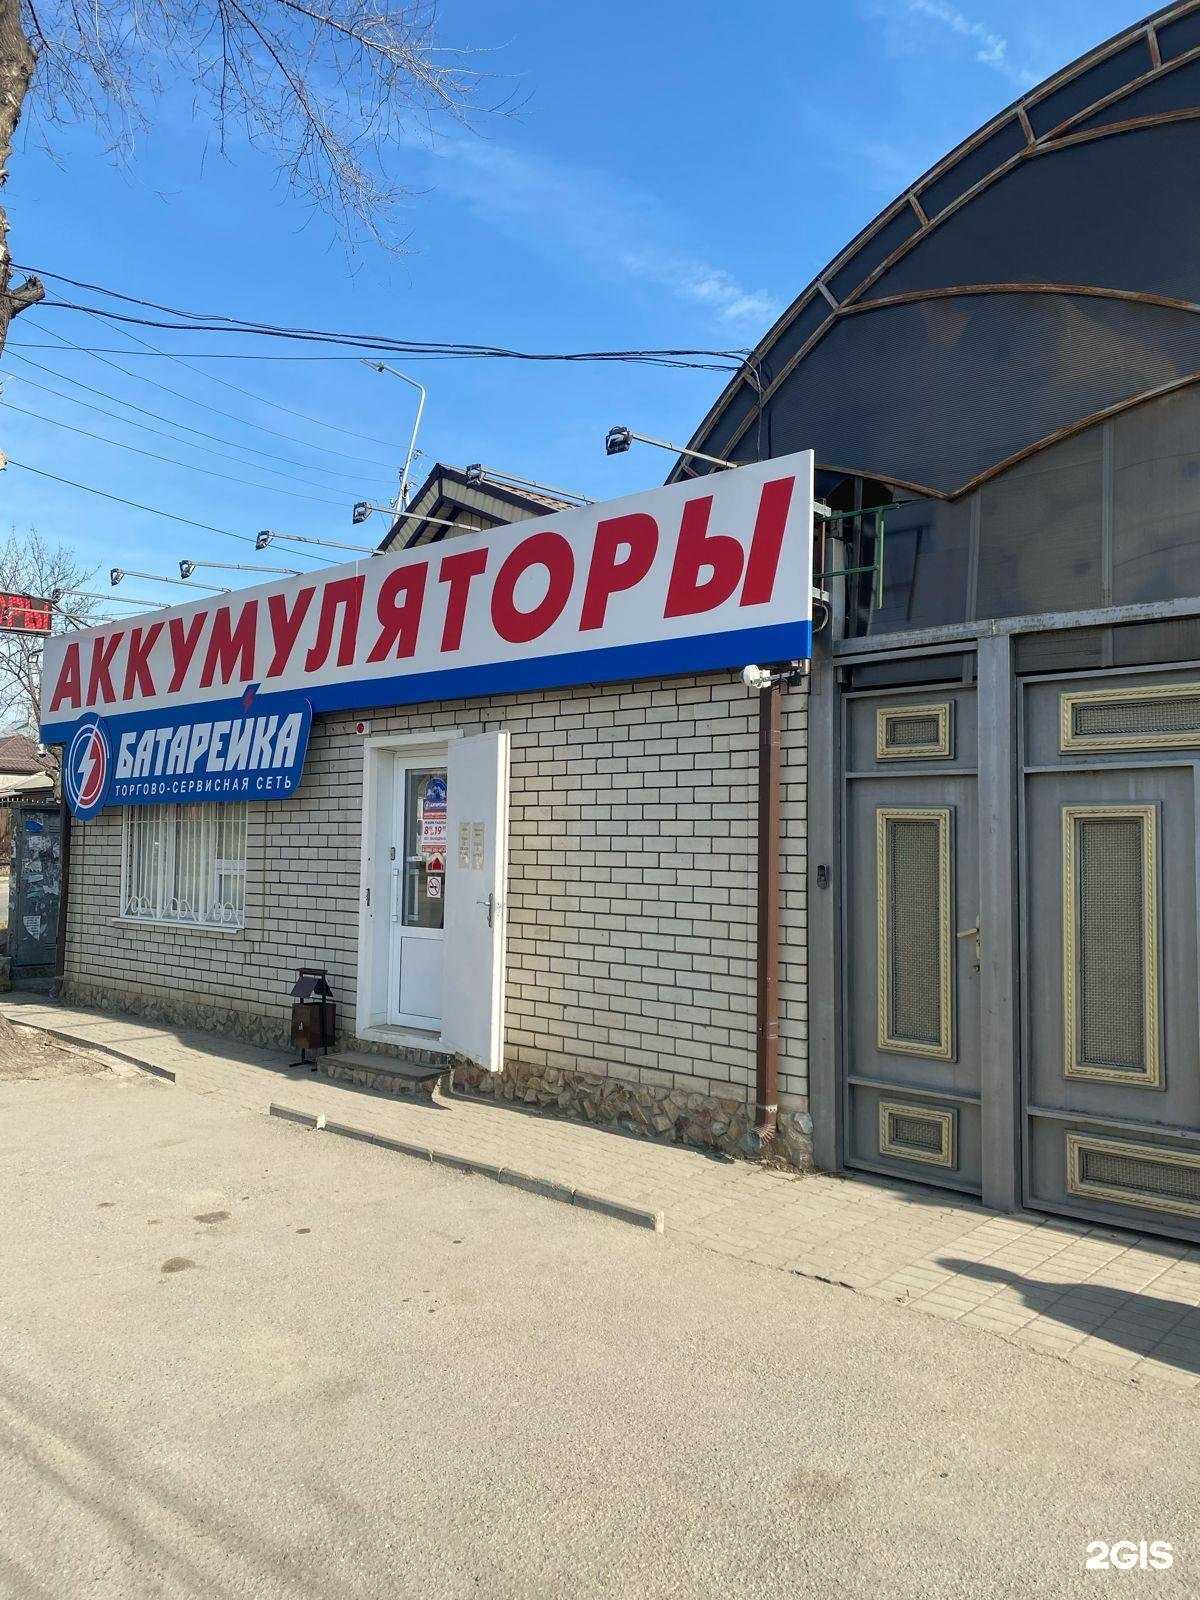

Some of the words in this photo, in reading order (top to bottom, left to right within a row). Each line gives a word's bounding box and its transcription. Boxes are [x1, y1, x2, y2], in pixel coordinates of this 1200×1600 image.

[50, 476, 796, 711] АККУМУЛЯТОРЫ
[115, 690, 303, 779] БАТАРЕЙКА
[115, 777, 249, 797] ТОРГОВО-СЕРВИСНАЯ
[256, 775, 292, 790] СЕТЬ
